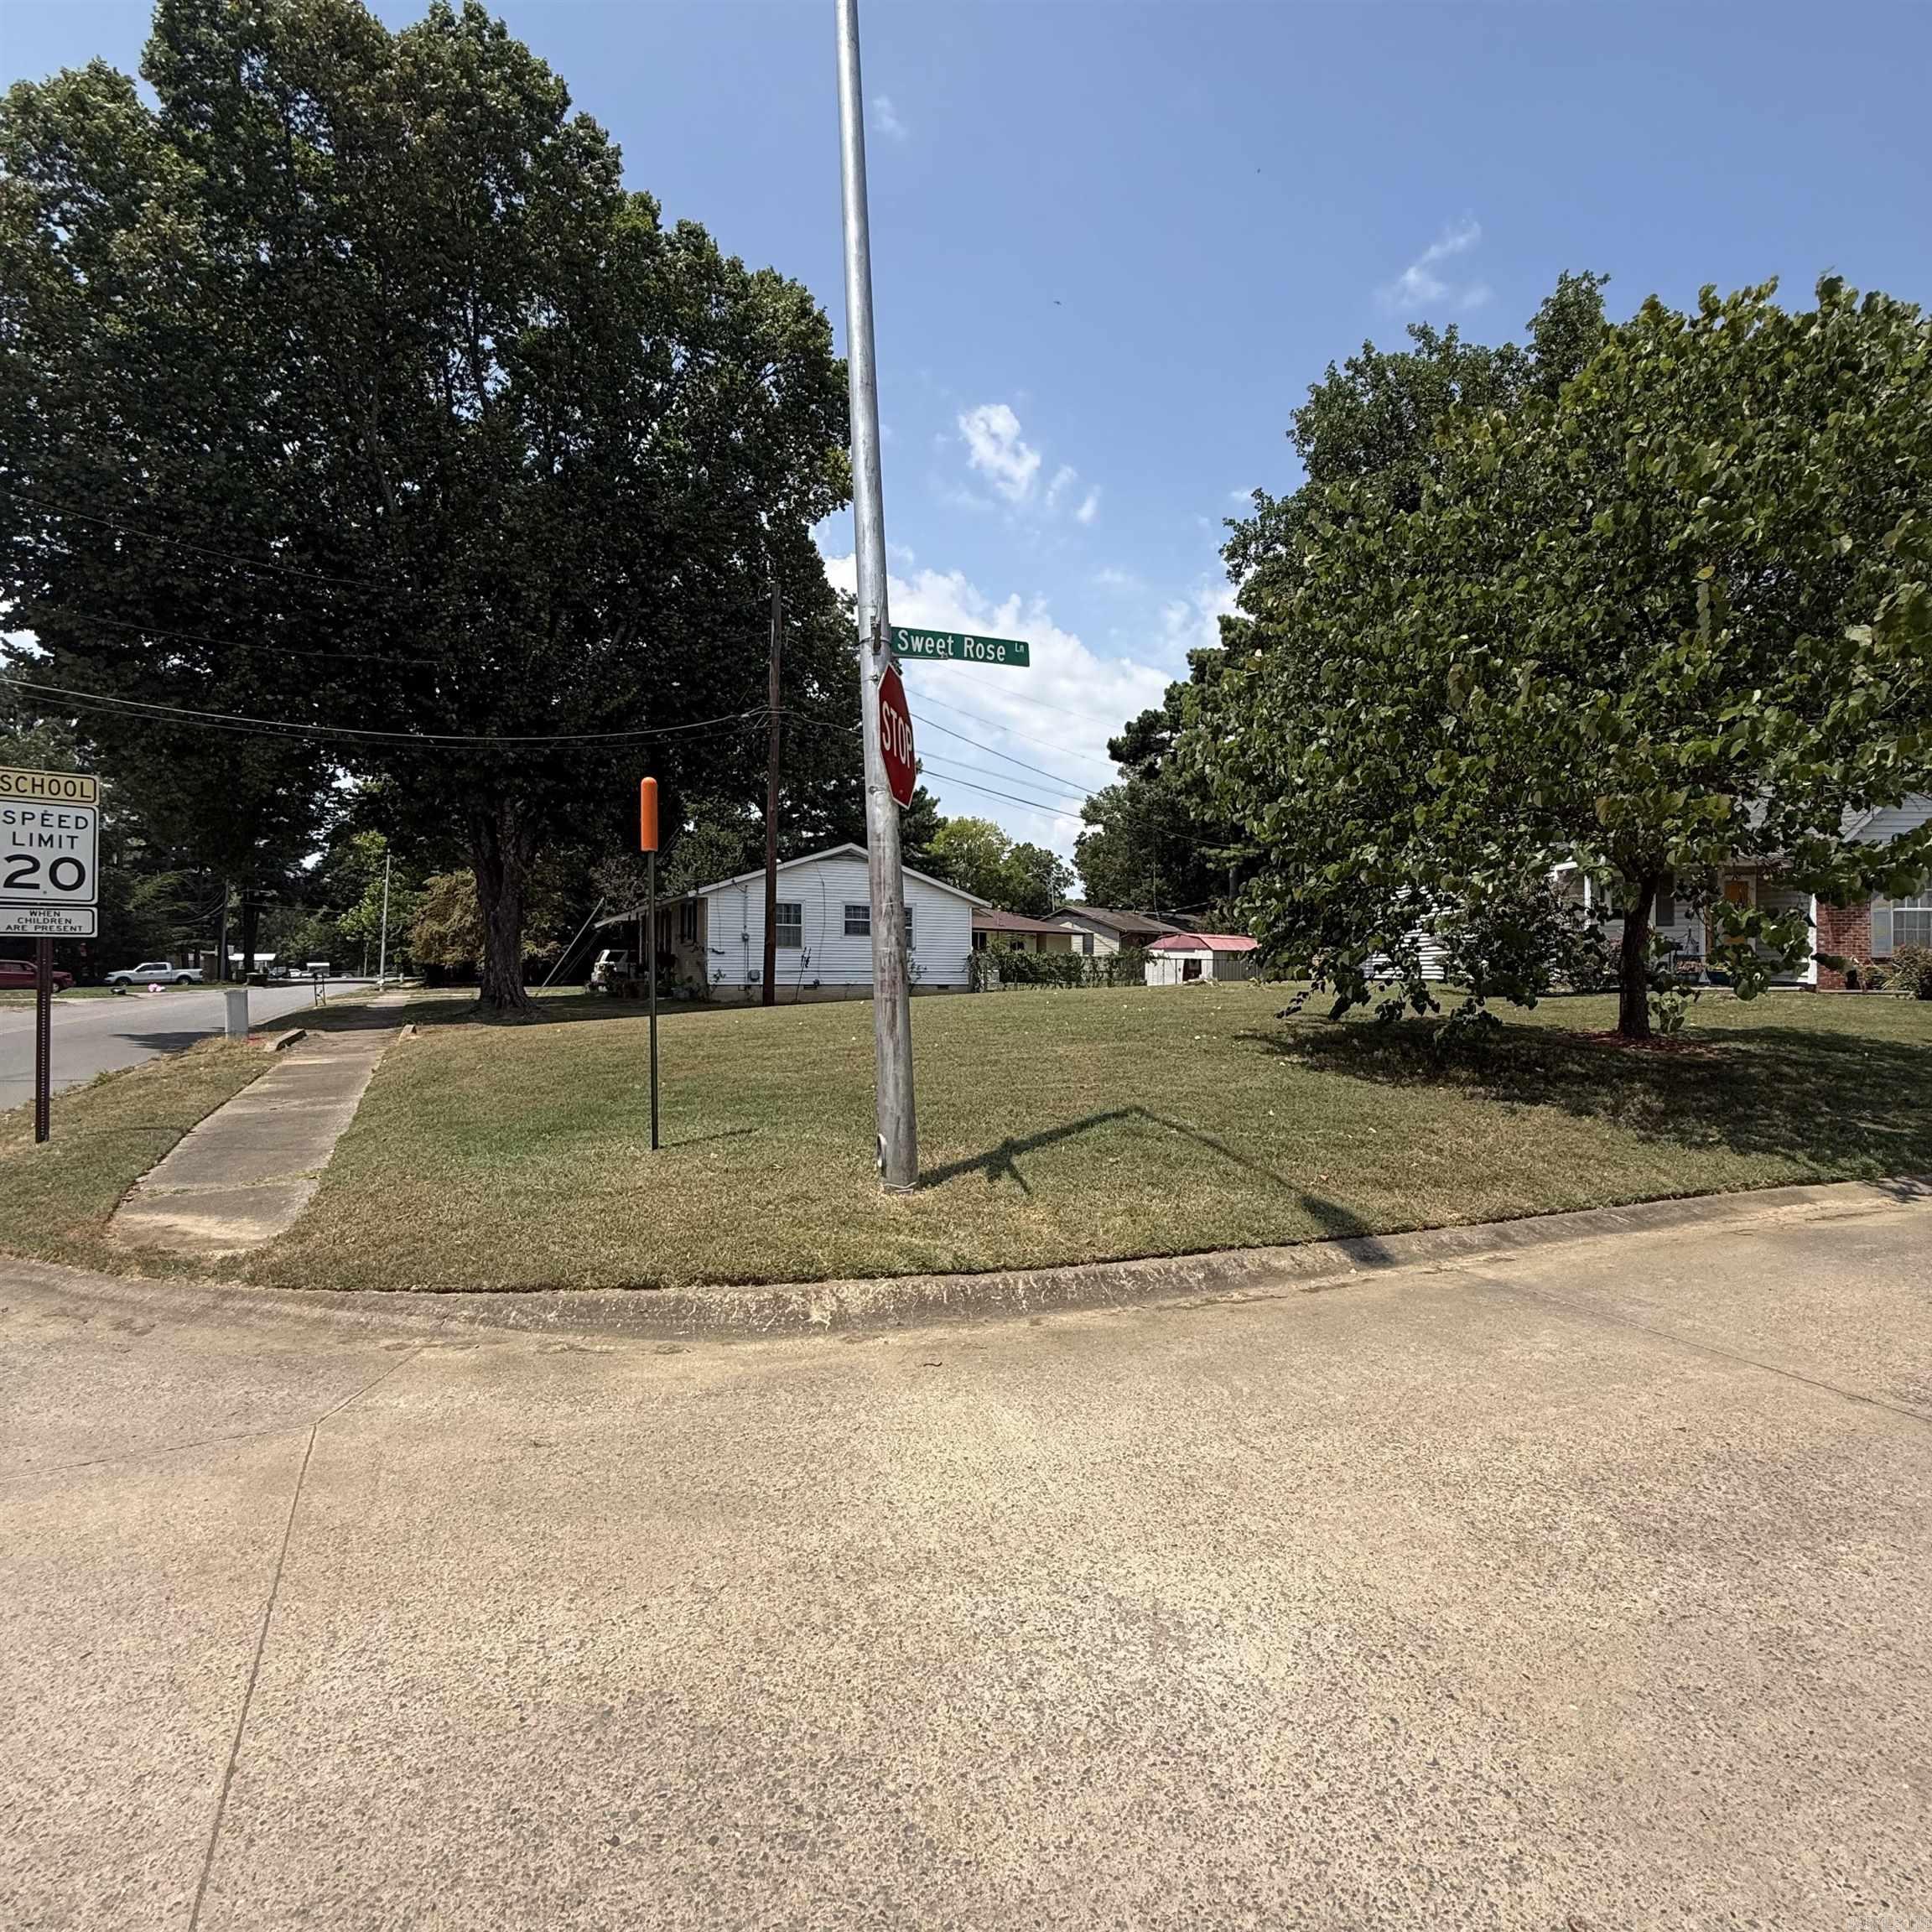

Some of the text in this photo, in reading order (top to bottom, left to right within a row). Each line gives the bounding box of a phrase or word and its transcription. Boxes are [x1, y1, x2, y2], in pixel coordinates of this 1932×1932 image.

[897, 629, 1025, 662] Sweet Rose Ln
[882, 700, 912, 769] STOP
[0, 775, 91, 798] SCHOOL
[3, 810, 88, 829] SPEED
[13, 832, 79, 849] LIMIT
[3, 854, 86, 891] 20
